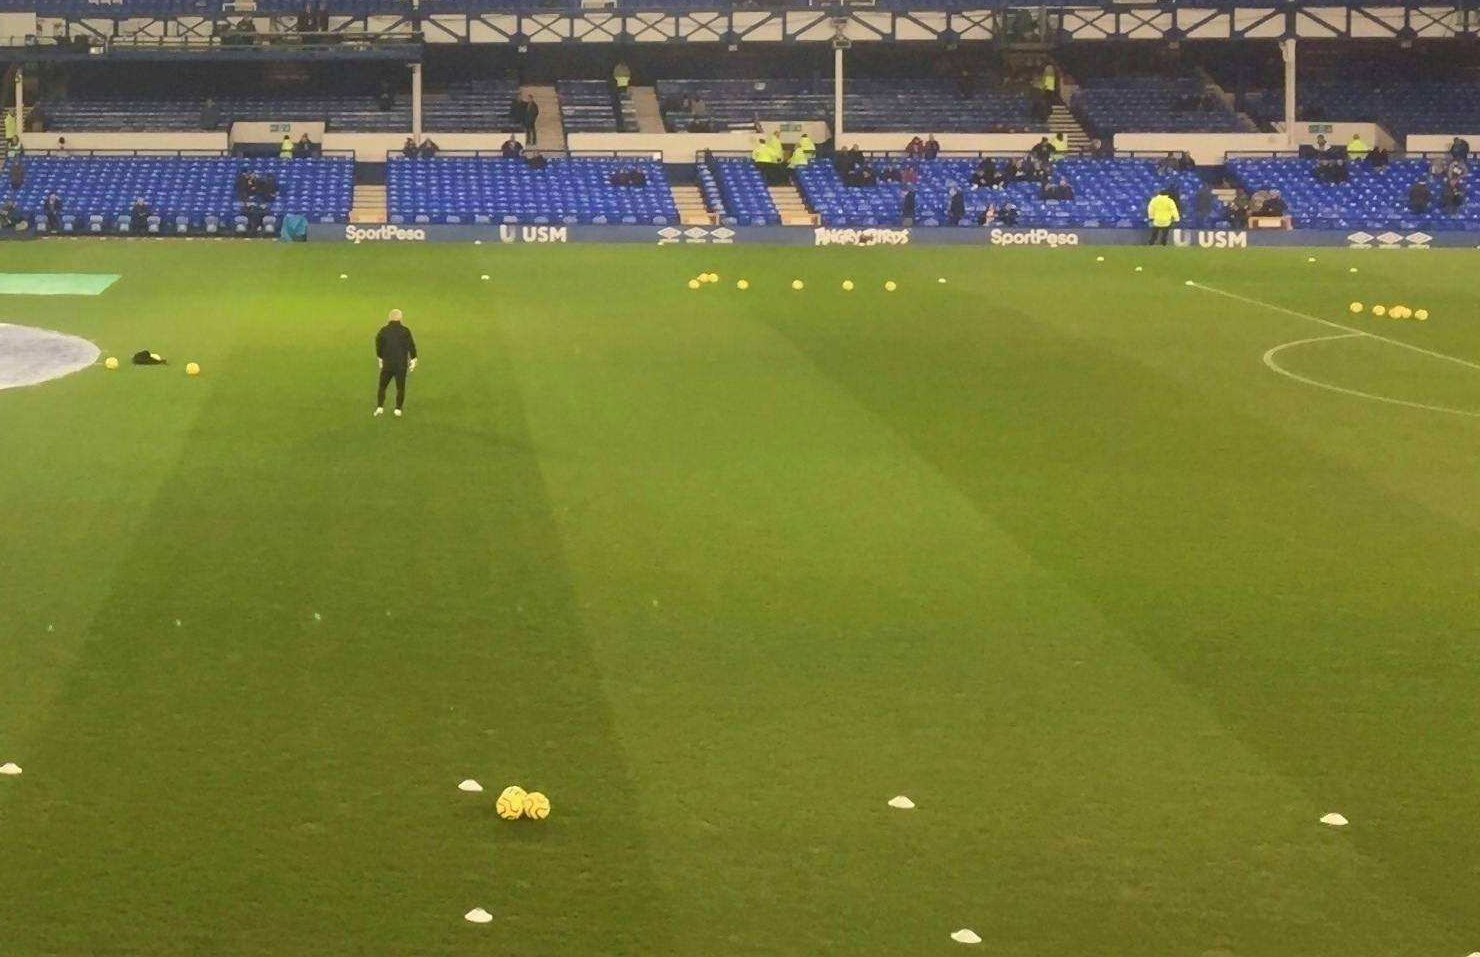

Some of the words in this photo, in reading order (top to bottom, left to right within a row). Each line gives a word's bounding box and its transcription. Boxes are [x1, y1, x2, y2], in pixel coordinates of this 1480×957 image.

[345, 224, 426, 243] SportPesa
[522, 226, 568, 243] USM
[990, 228, 1079, 246] SportPesa
[1198, 231, 1248, 248] USM
